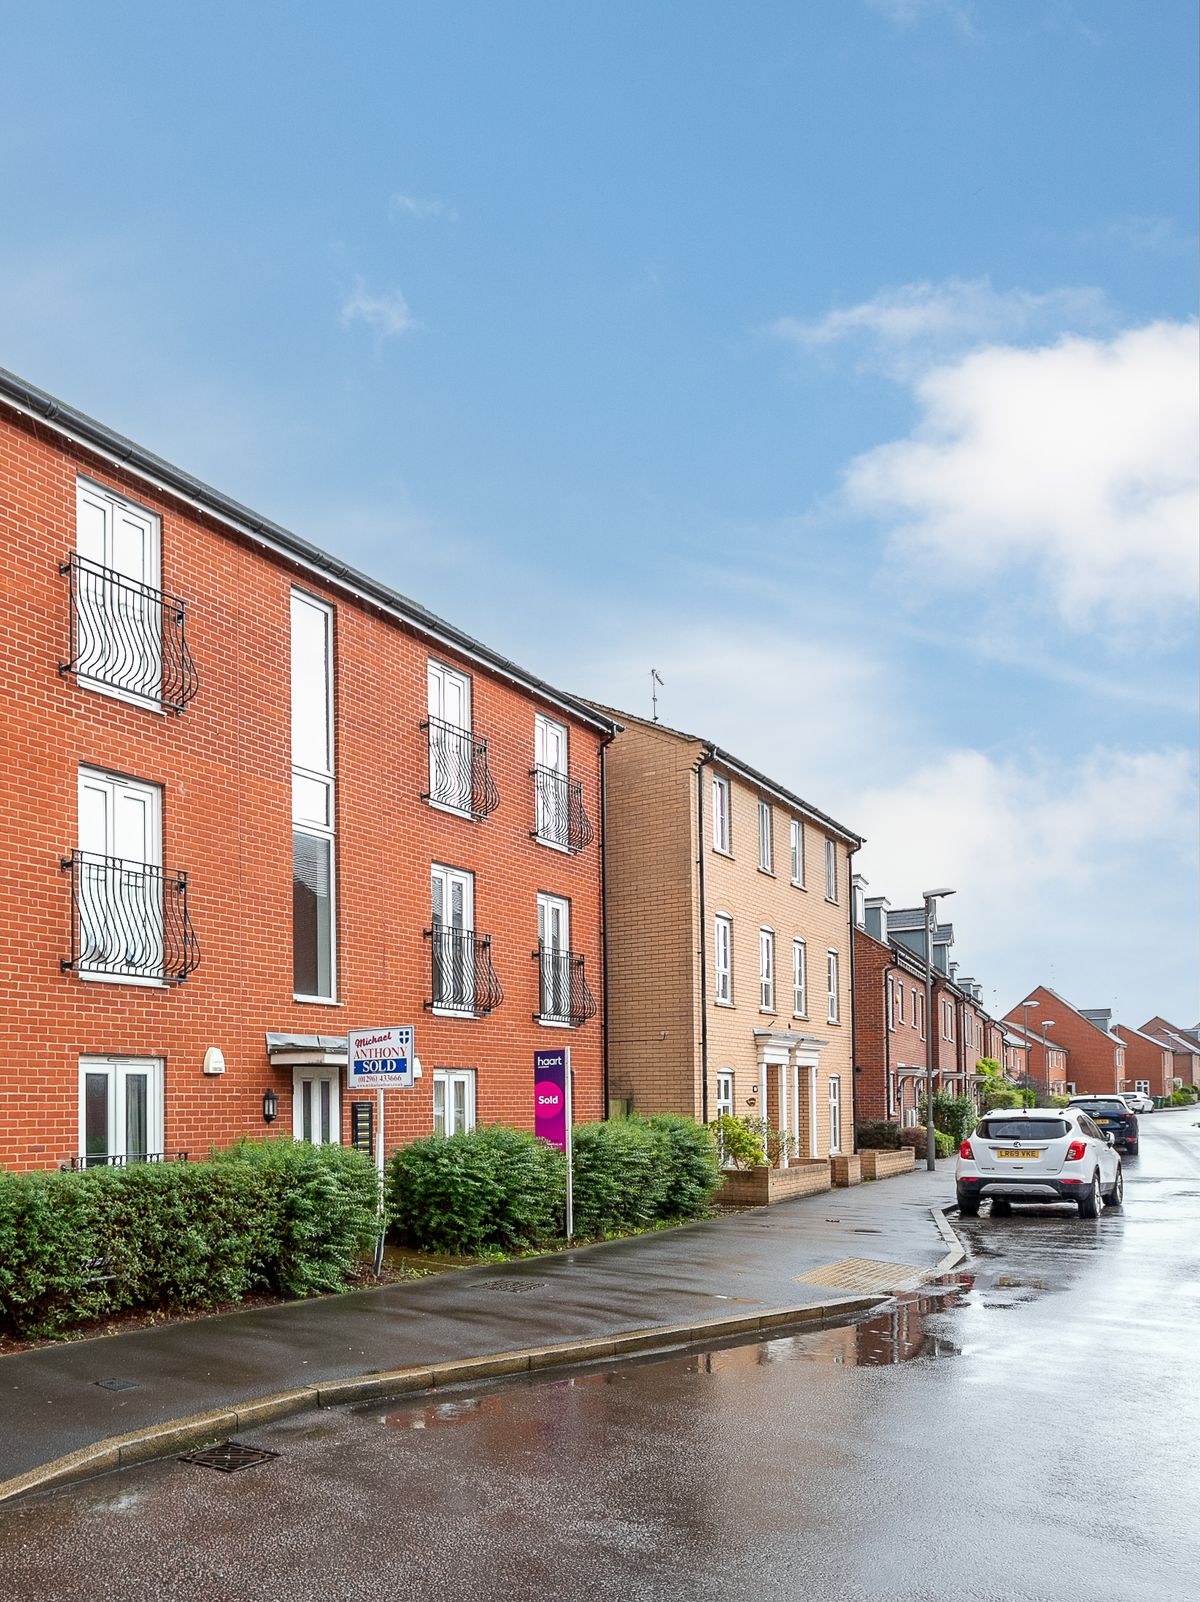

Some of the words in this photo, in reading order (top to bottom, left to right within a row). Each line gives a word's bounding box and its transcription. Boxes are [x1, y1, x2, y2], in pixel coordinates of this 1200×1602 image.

[355, 1032, 392, 1048] Michael
[353, 1046, 407, 1059] ANTHONY
[362, 1060, 397, 1072] SOLD
[537, 1056, 562, 1066] haart
[538, 1095, 558, 1105] Sold
